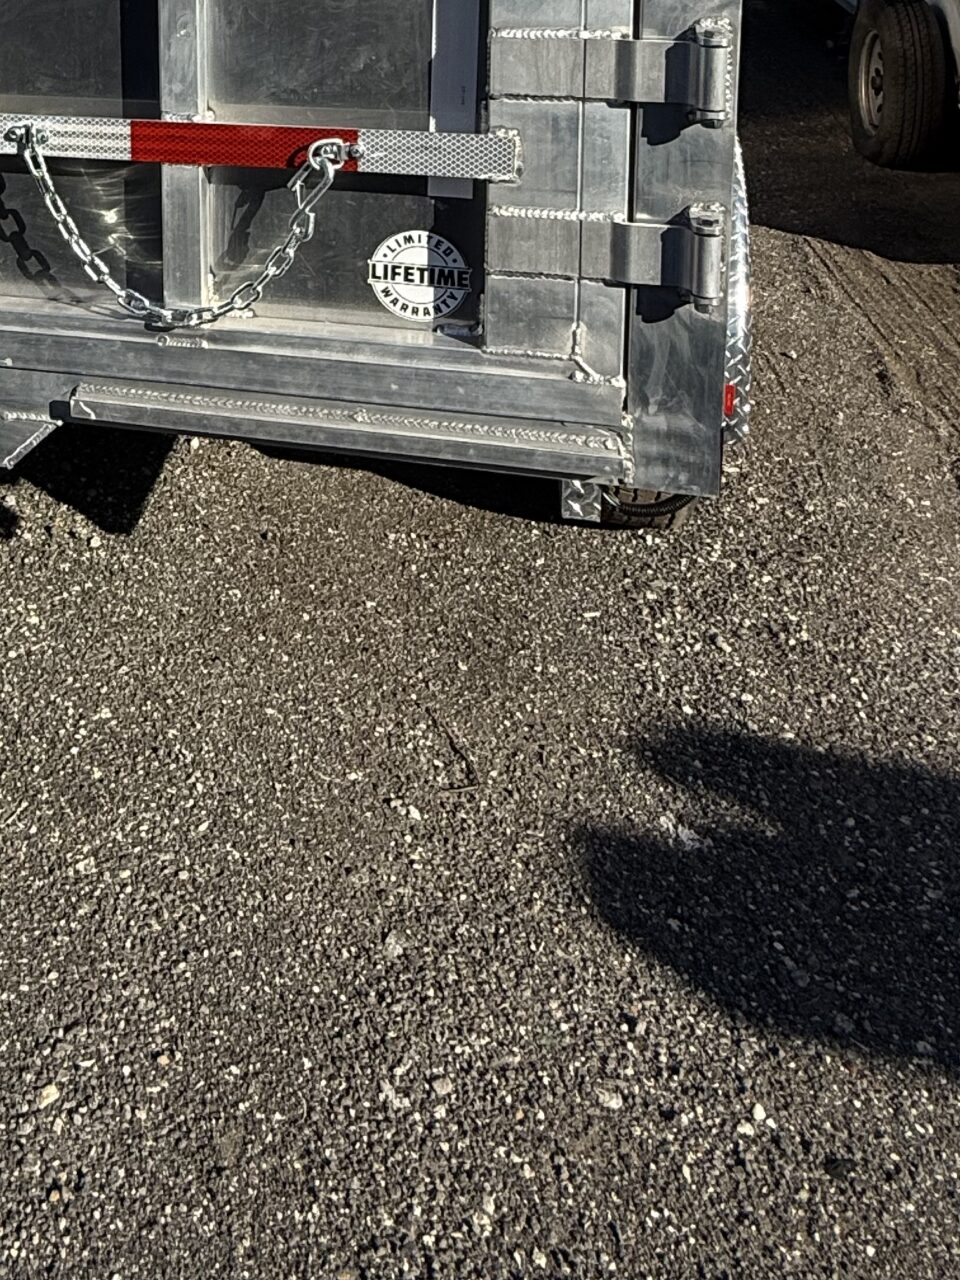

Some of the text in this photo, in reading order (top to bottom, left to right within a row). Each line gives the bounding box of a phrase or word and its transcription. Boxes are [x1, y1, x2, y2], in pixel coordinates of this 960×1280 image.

[386, 233, 455, 258] LIMITED
[371, 263, 469, 288] LIFETIME
[380, 286, 460, 317] WARRANTY
